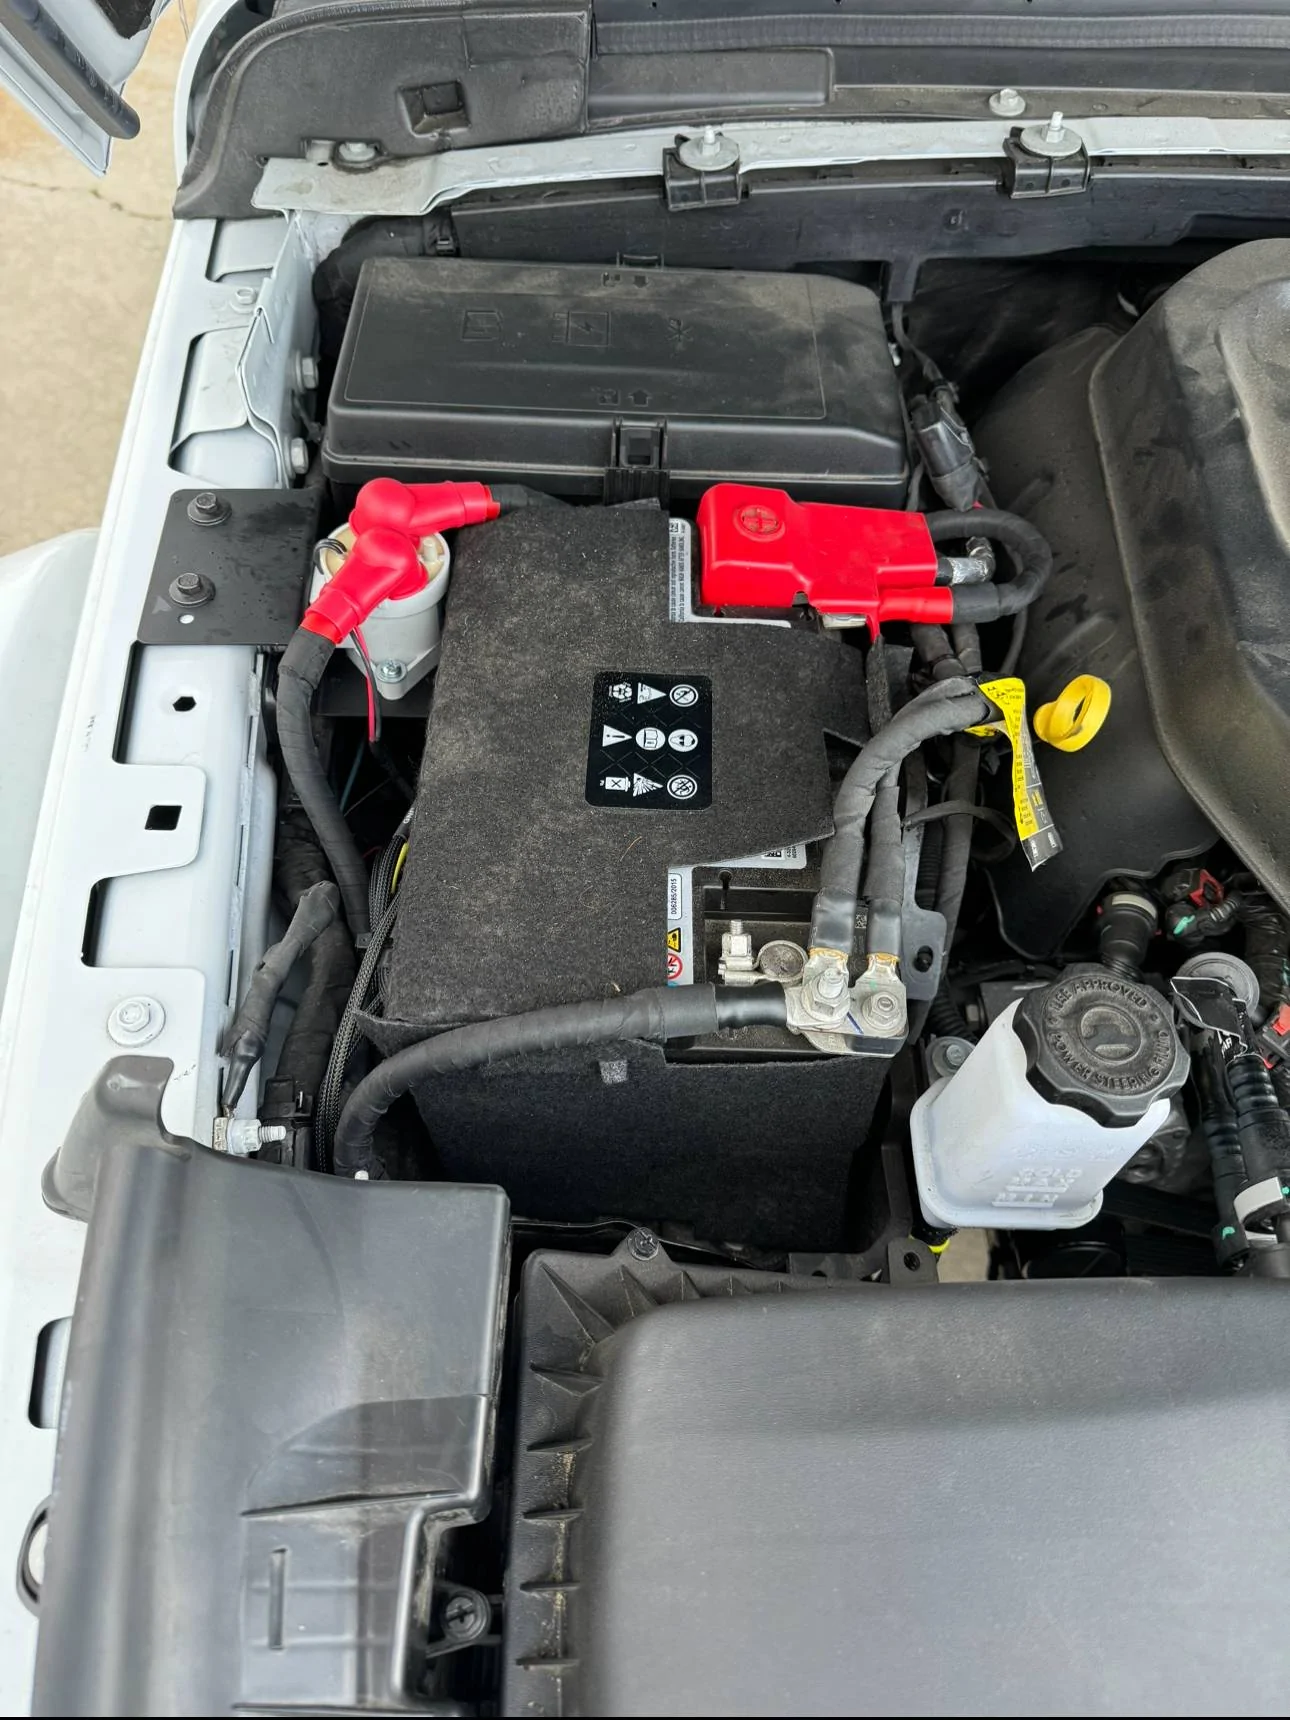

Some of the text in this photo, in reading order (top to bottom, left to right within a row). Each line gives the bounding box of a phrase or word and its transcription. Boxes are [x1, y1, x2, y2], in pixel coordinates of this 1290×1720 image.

[1049, 979, 1148, 1012] USE APPROVED
[1048, 1030, 1171, 1089] POWER STEERING FLUID
[1018, 1167, 1082, 1178] COLD
